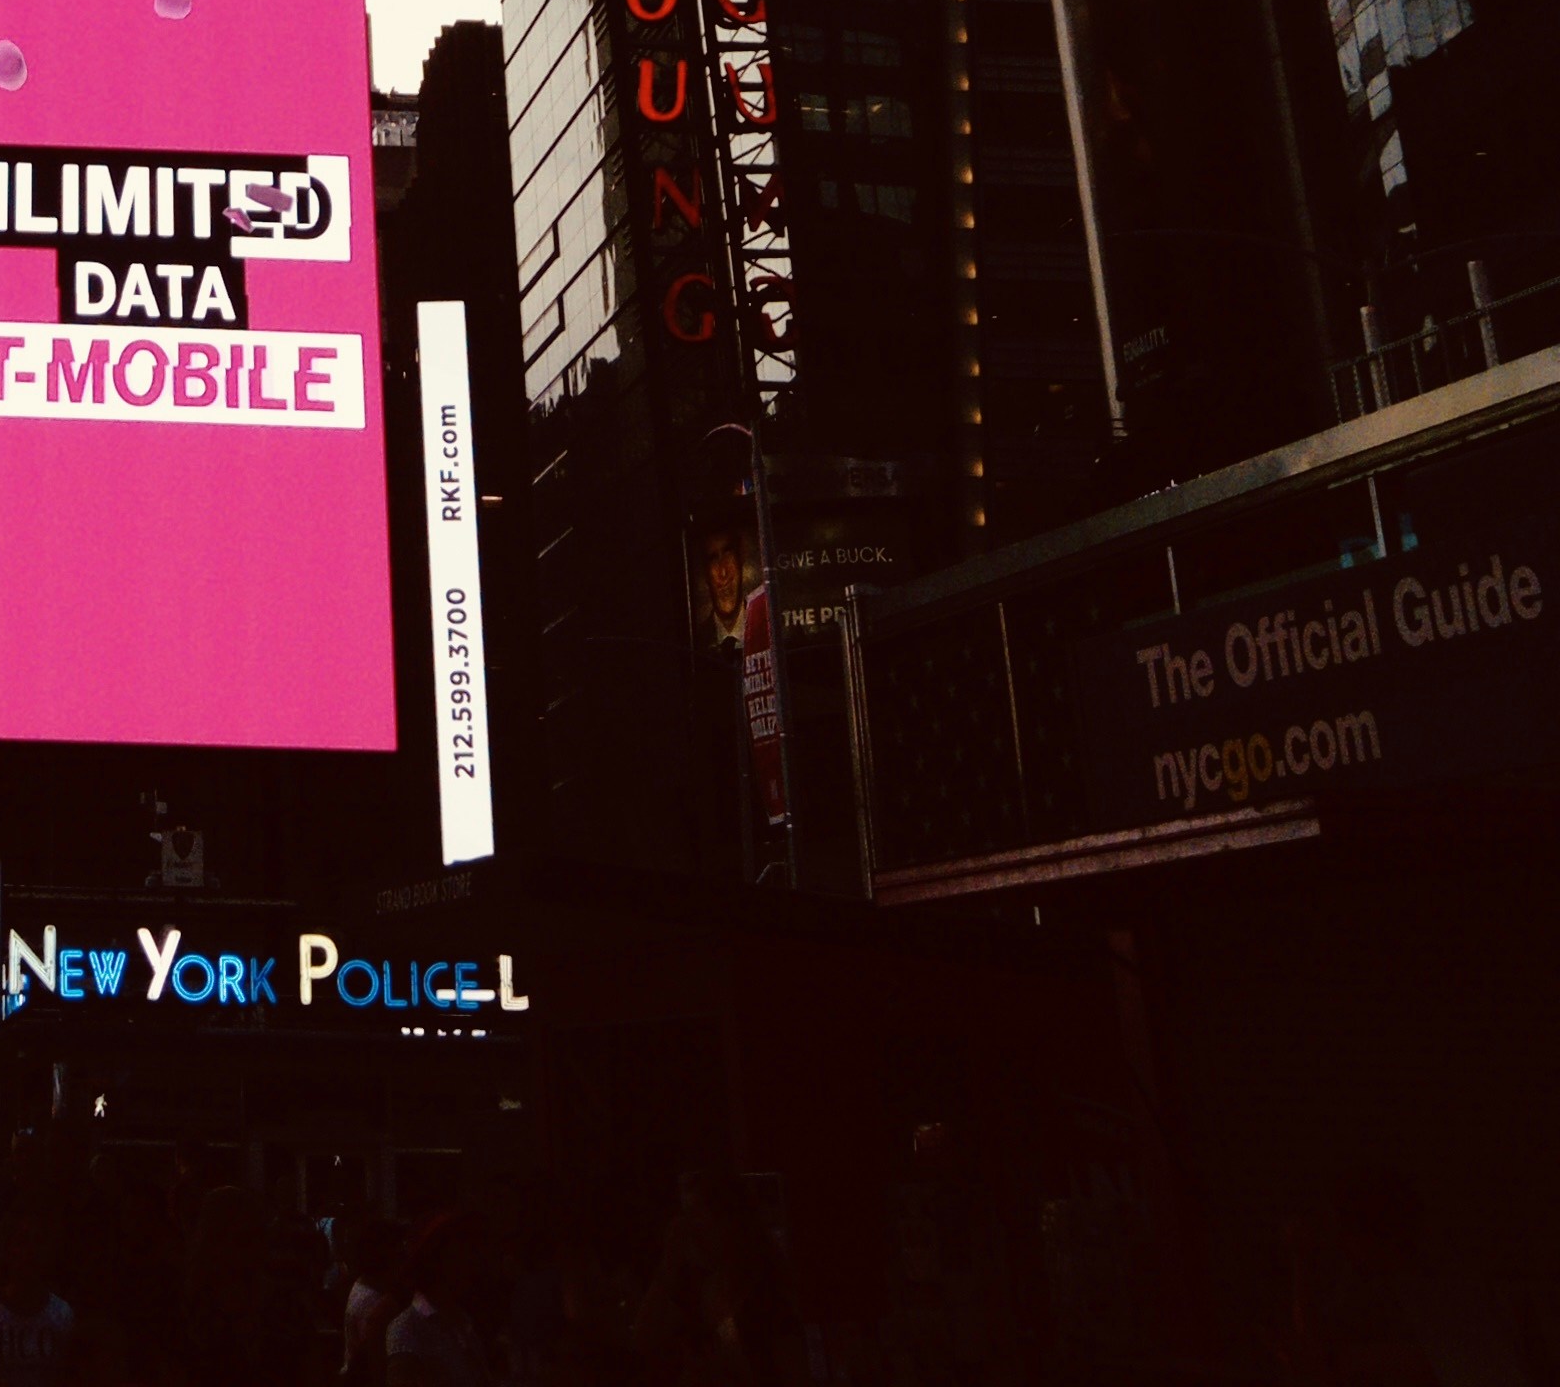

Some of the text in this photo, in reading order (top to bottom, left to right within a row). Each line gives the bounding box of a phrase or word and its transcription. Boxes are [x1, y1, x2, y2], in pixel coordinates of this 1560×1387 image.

[74, 262, 237, 321] DATA
[439, 402, 463, 524] RKF.com
[777, 545, 894, 571] GIVE A BUCK.
[781, 607, 816, 628] THE
[1135, 553, 1545, 710] The Official Guide
[444, 585, 477, 780] 212.599.3700
[1153, 708, 1383, 811] nycgo.com
[8, 924, 127, 999] NEW
[136, 927, 278, 1005] YORK
[298, 933, 482, 1012] POLICE
